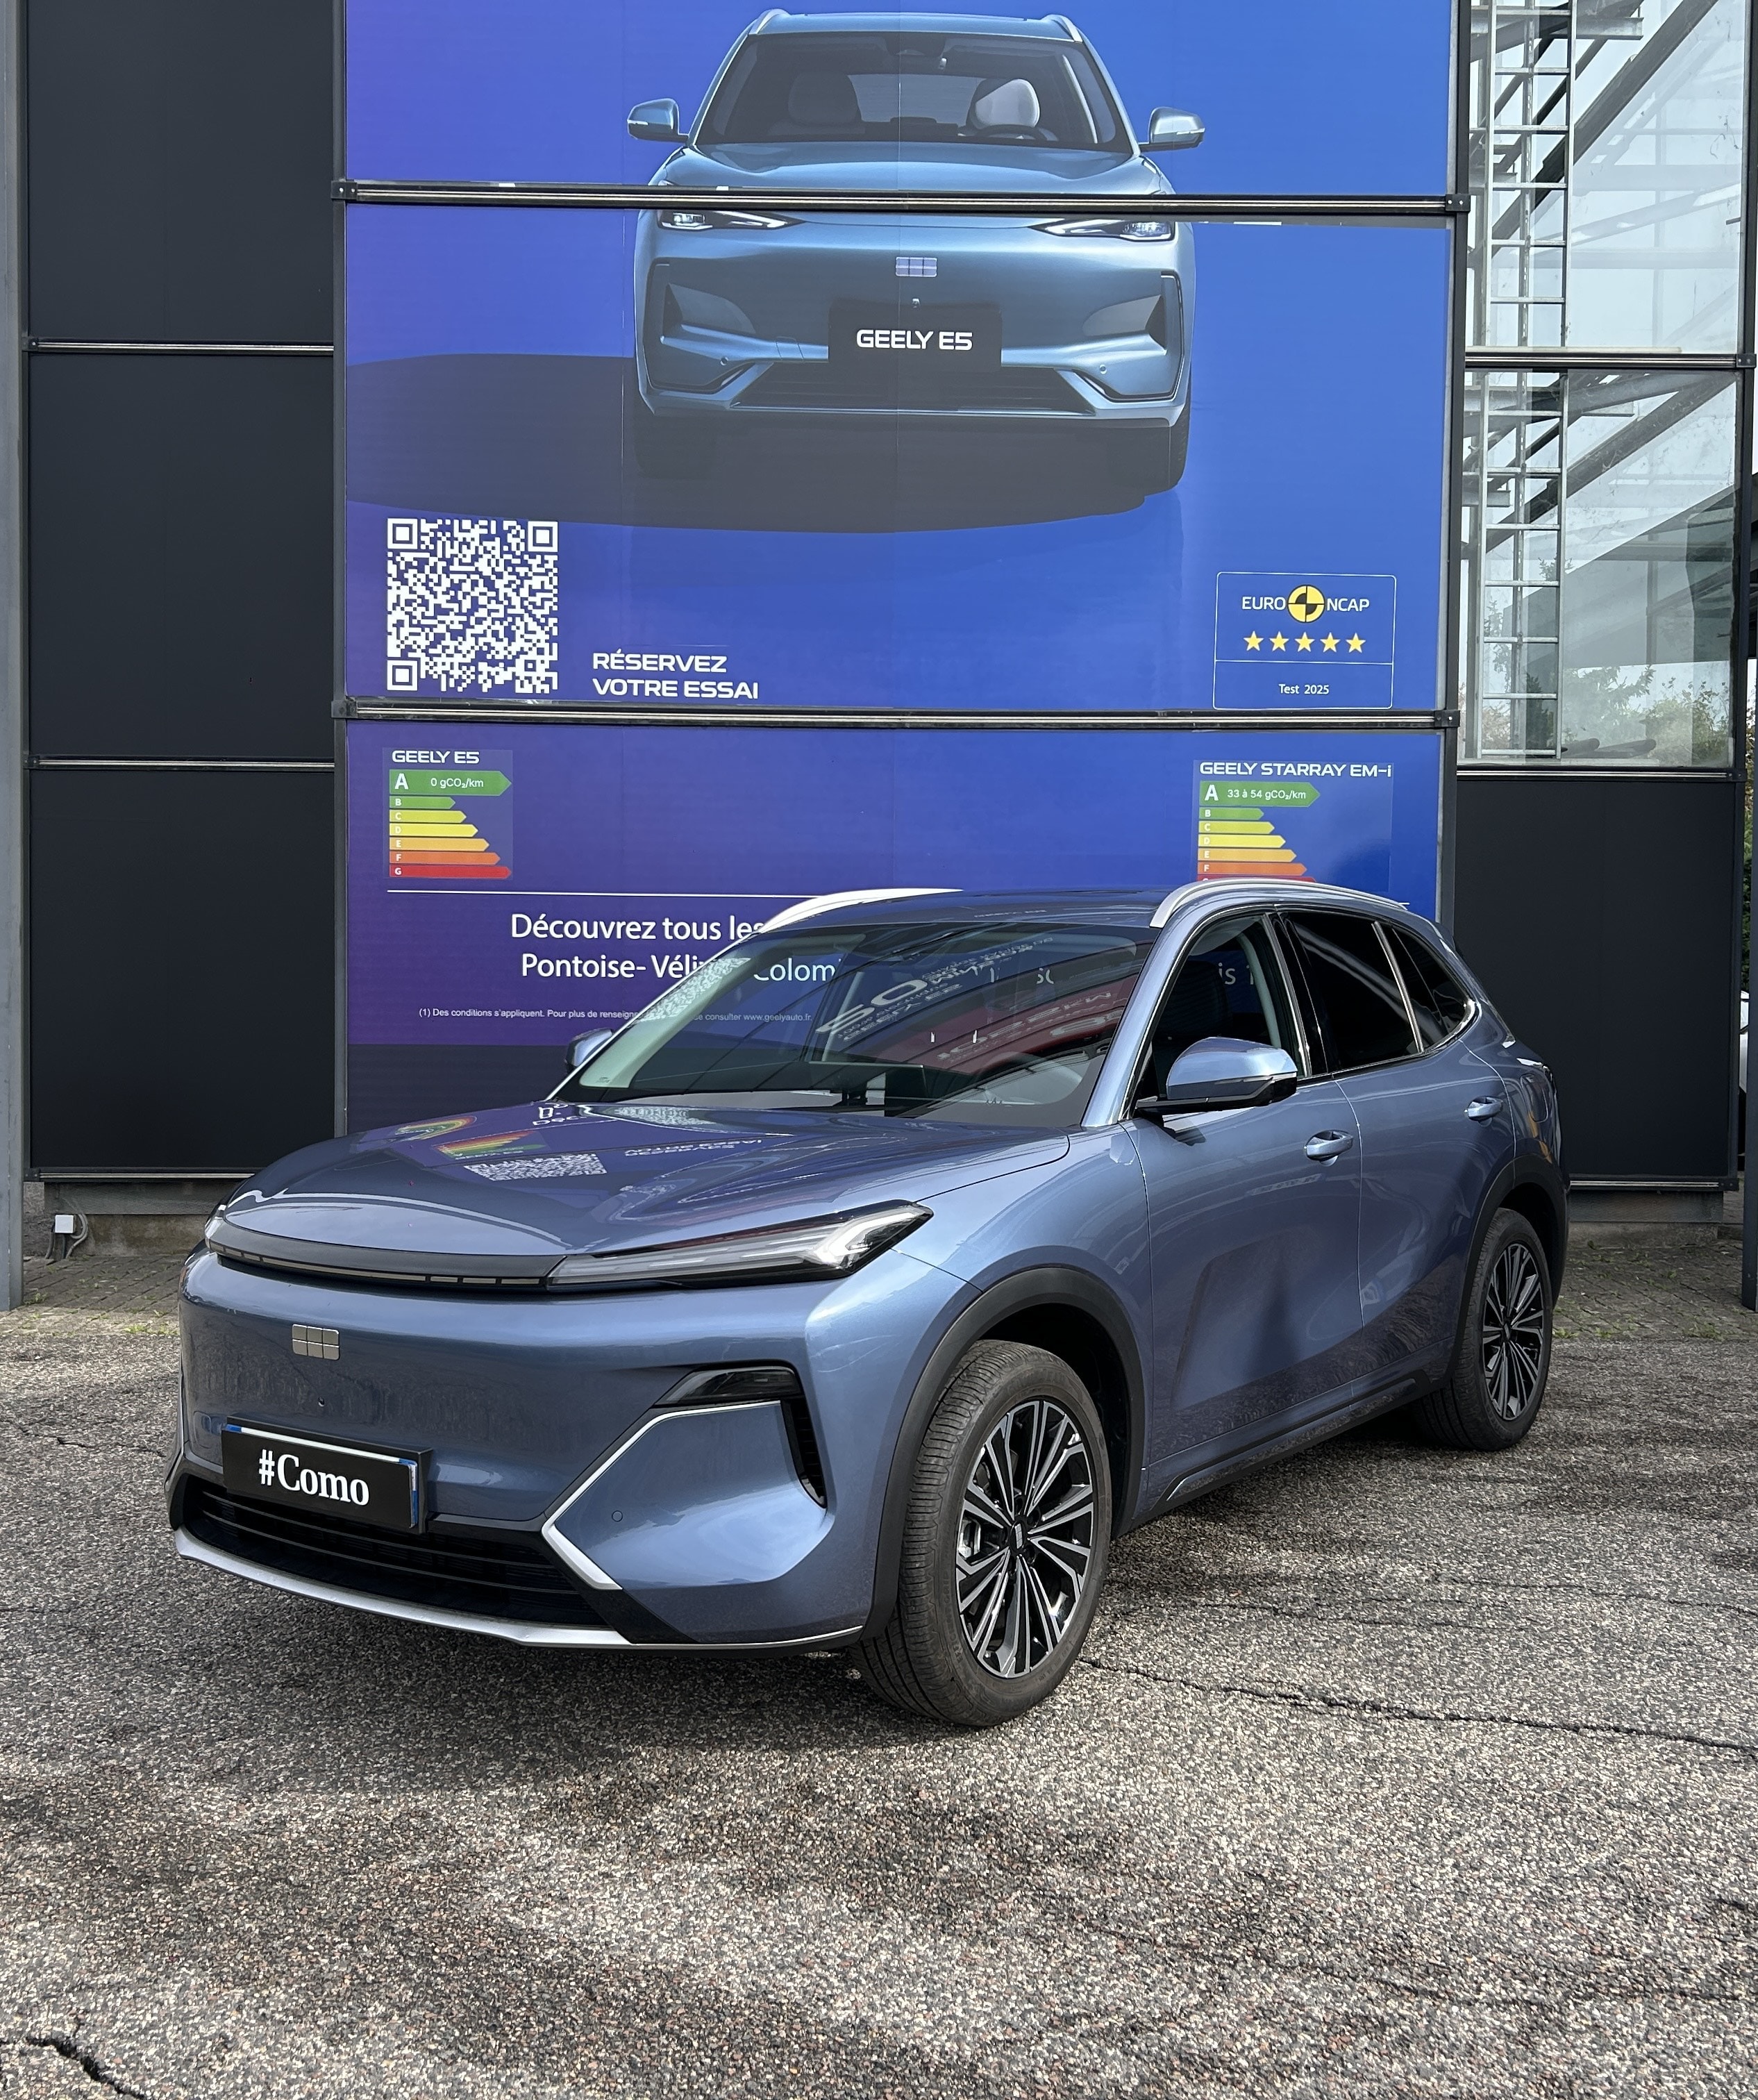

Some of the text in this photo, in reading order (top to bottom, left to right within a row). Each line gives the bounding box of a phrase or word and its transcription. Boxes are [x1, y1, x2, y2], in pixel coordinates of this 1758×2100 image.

[856, 329, 973, 351] GEELY E5
[1241, 597, 1370, 612] EURO NCAP
[593, 649, 727, 673] RÉSERVEZ
[592, 678, 758, 699] VOTRE ESSAI
[1279, 683, 1330, 695] Test 2025
[392, 750, 480, 764] GEELY E5
[1200, 762, 1392, 778] GEELY STARRAY EM-i
[394, 773, 409, 790] A
[430, 778, 437, 787] 0
[1204, 784, 1219, 801] A
[1227, 790, 1239, 798] 33
[1241, 789, 1248, 798] à
[1250, 790, 1262, 798] 54
[1203, 837, 1210, 845] D
[396, 853, 402, 862] F
[1203, 864, 1209, 872] F
[512, 913, 656, 940] Découvrez
[662, 917, 721, 940] tous
[522, 953, 646, 978] Pontoise-
[651, 953, 704, 978] Véli
[753, 958, 842, 981] olom
[419, 1008, 431, 1018] (1)
[433, 1008, 449, 1017] Des
[451, 1008, 492, 1017] conditions
[547, 1009, 567, 1017] Pour
[569, 1010, 586, 1019] plus
[258, 1449, 369, 1506] #Como
